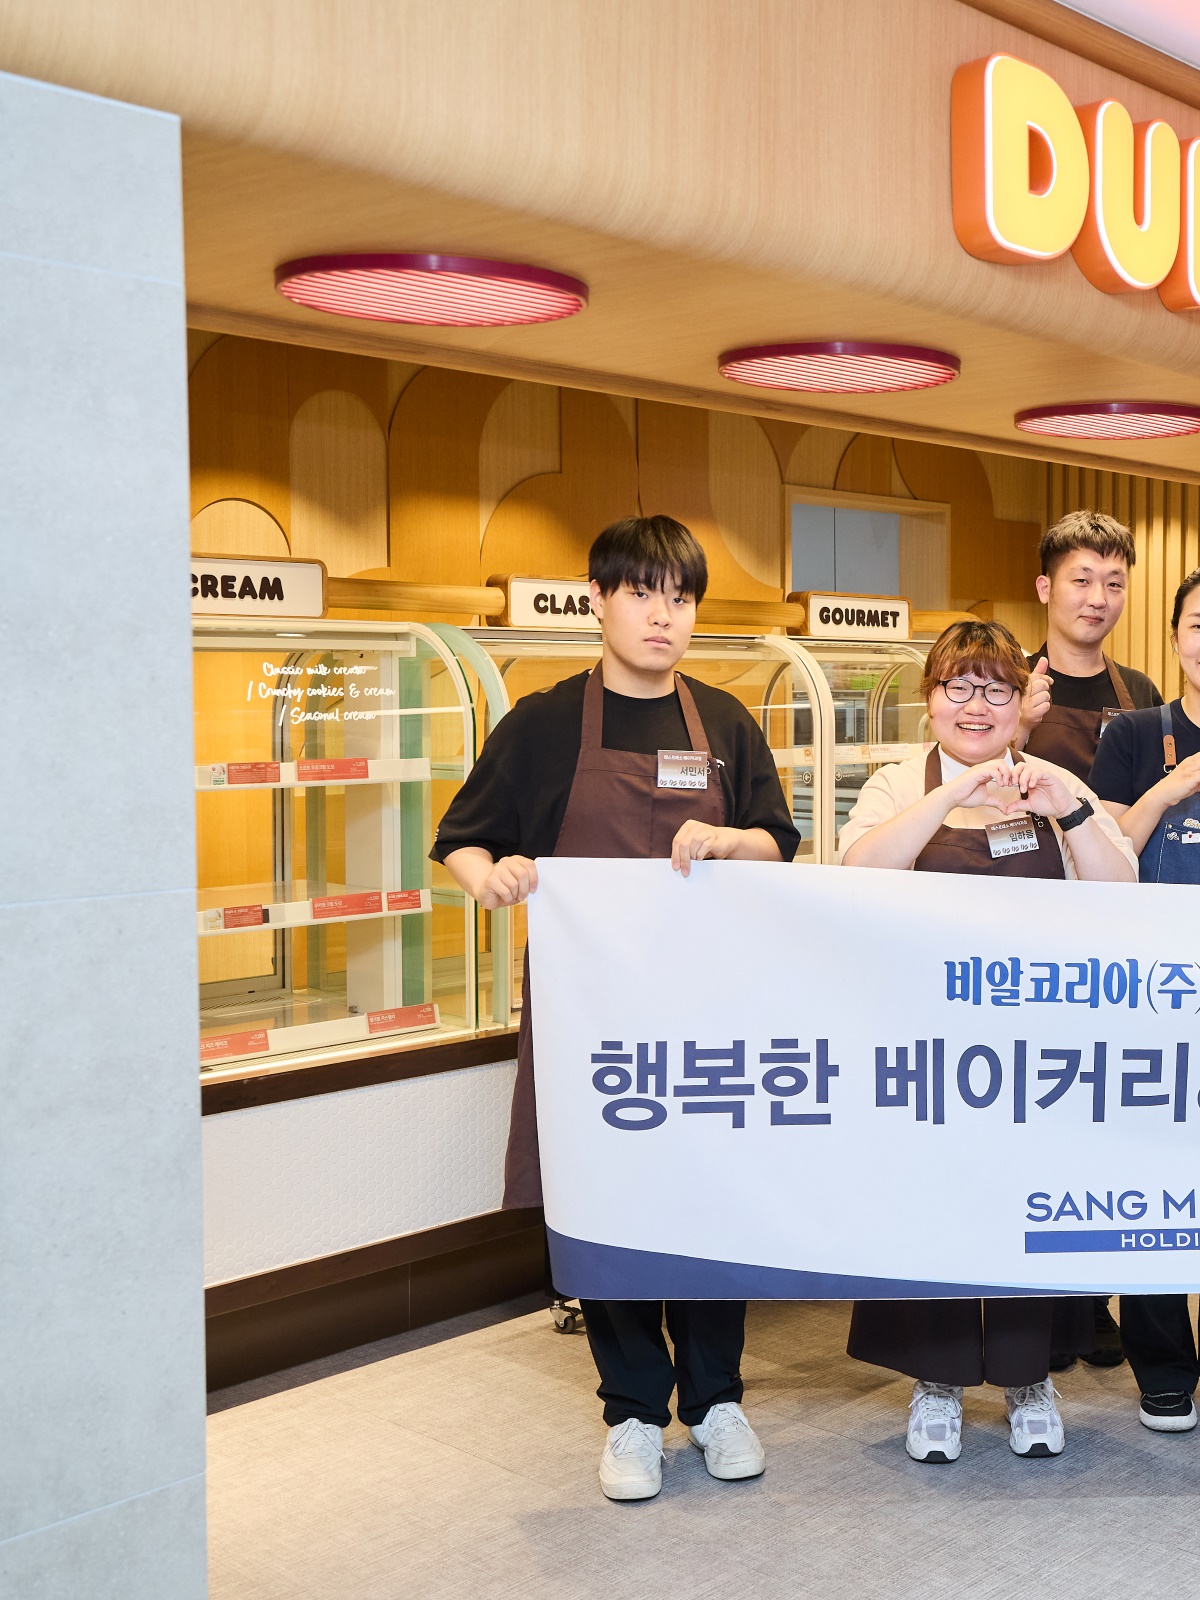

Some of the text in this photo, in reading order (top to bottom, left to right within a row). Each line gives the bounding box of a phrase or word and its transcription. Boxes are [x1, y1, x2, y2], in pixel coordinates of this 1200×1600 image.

[533, 592, 596, 616] CLAS
[818, 606, 900, 628] GOURMET
[262, 662, 367, 677] Classic milk cream
[258, 682, 305, 702] Crunchy
[306, 683, 345, 697] cookies
[363, 687, 397, 696] cream
[290, 706, 340, 725] Seasonal
[343, 711, 376, 721] cream
[680, 766, 706, 776] 서민서
[591, 1038, 839, 1131] 행복한
[1025, 1190, 1148, 1222] SANG
